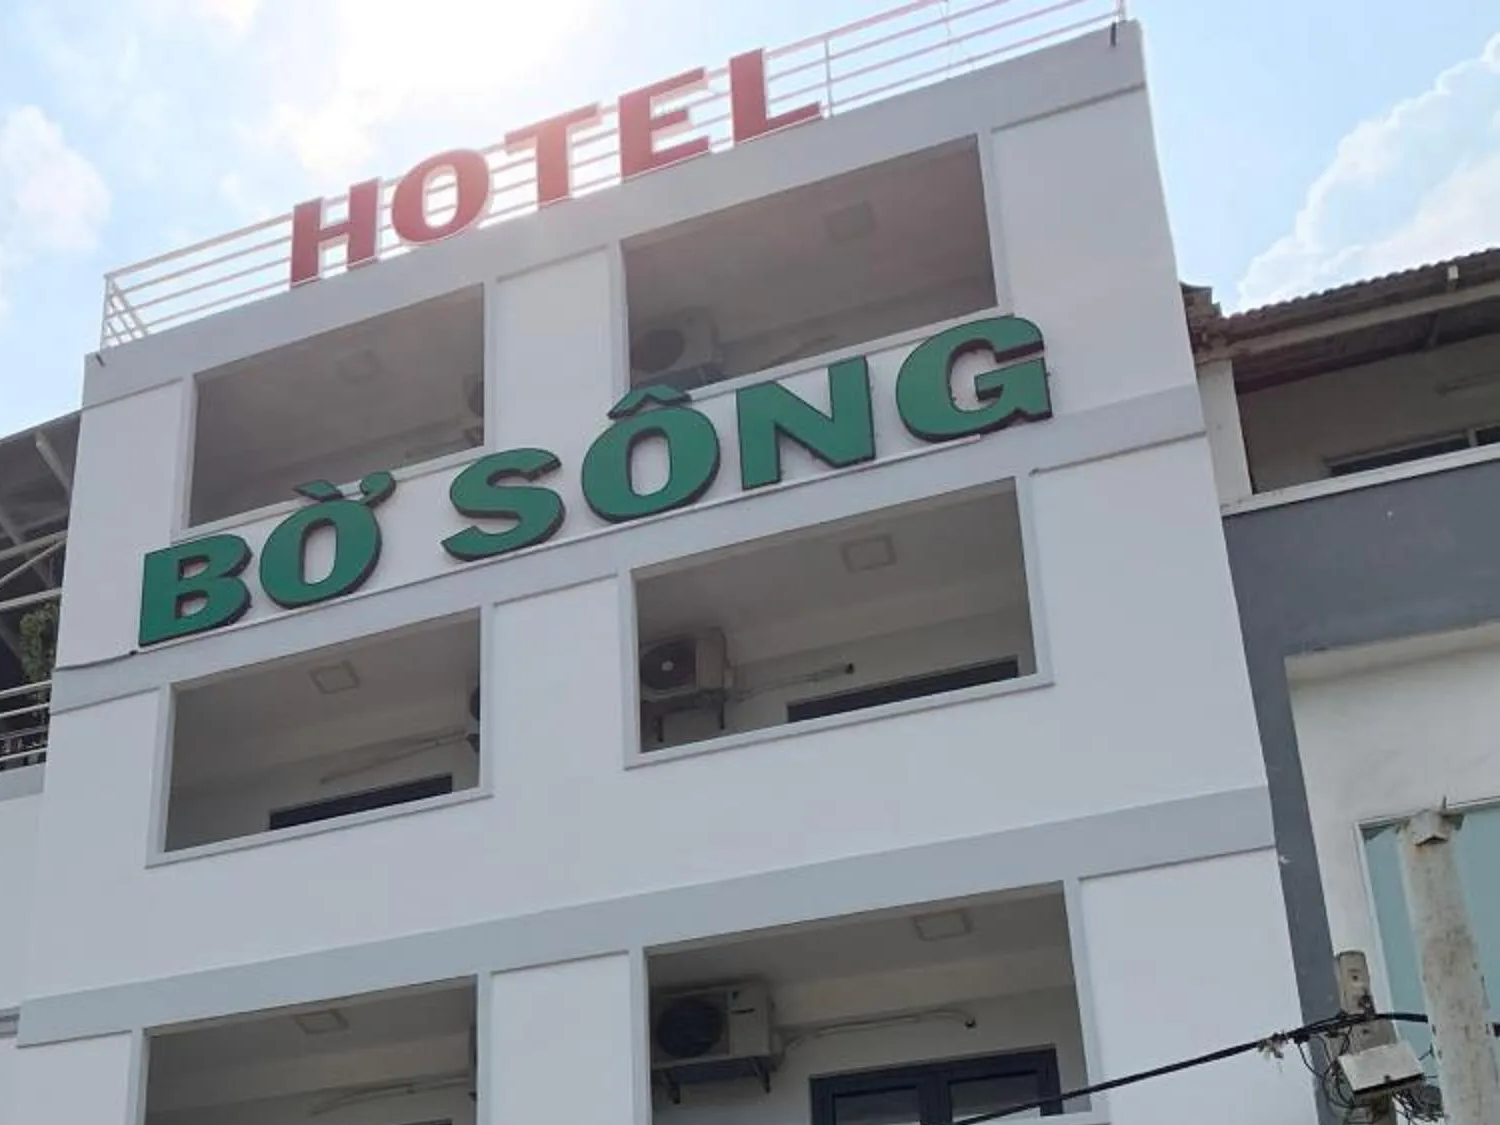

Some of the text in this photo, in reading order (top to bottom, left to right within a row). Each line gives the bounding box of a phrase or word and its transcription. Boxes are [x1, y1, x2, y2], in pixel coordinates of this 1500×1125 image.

[290, 48, 822, 289] HOTEL
[138, 314, 1053, 647] BỜ SÔNG
